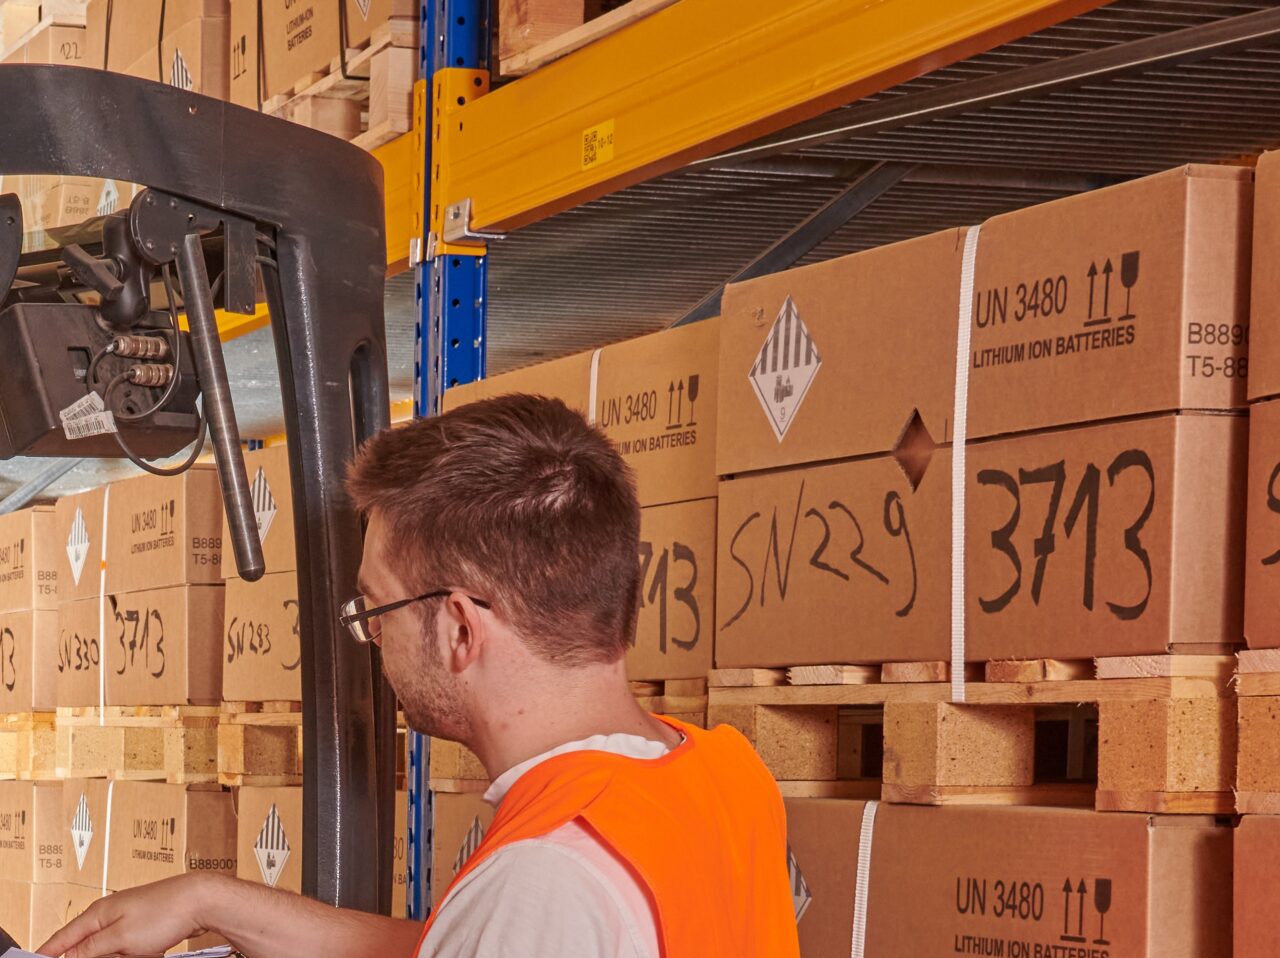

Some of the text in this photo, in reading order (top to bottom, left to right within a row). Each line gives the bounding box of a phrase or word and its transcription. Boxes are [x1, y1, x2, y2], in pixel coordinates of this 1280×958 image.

[287, 24, 313, 51] BATTERIES
[60, 41, 82, 60] 122
[976, 275, 1067, 328] UN 3480
[973, 325, 1135, 369] LITHIUM ION BATTERIES
[601, 390, 656, 428] UN 3480
[632, 438, 647, 453] ION
[649, 430, 697, 451] BATTERIES
[977, 449, 1154, 621] 3713
[192, 553, 222, 565] T5-8
[38, 585, 57, 594] T5-
[133, 819, 142, 839] UN
[956, 877, 1044, 921] UN 3480
[955, 935, 1004, 957] LITHIUM
